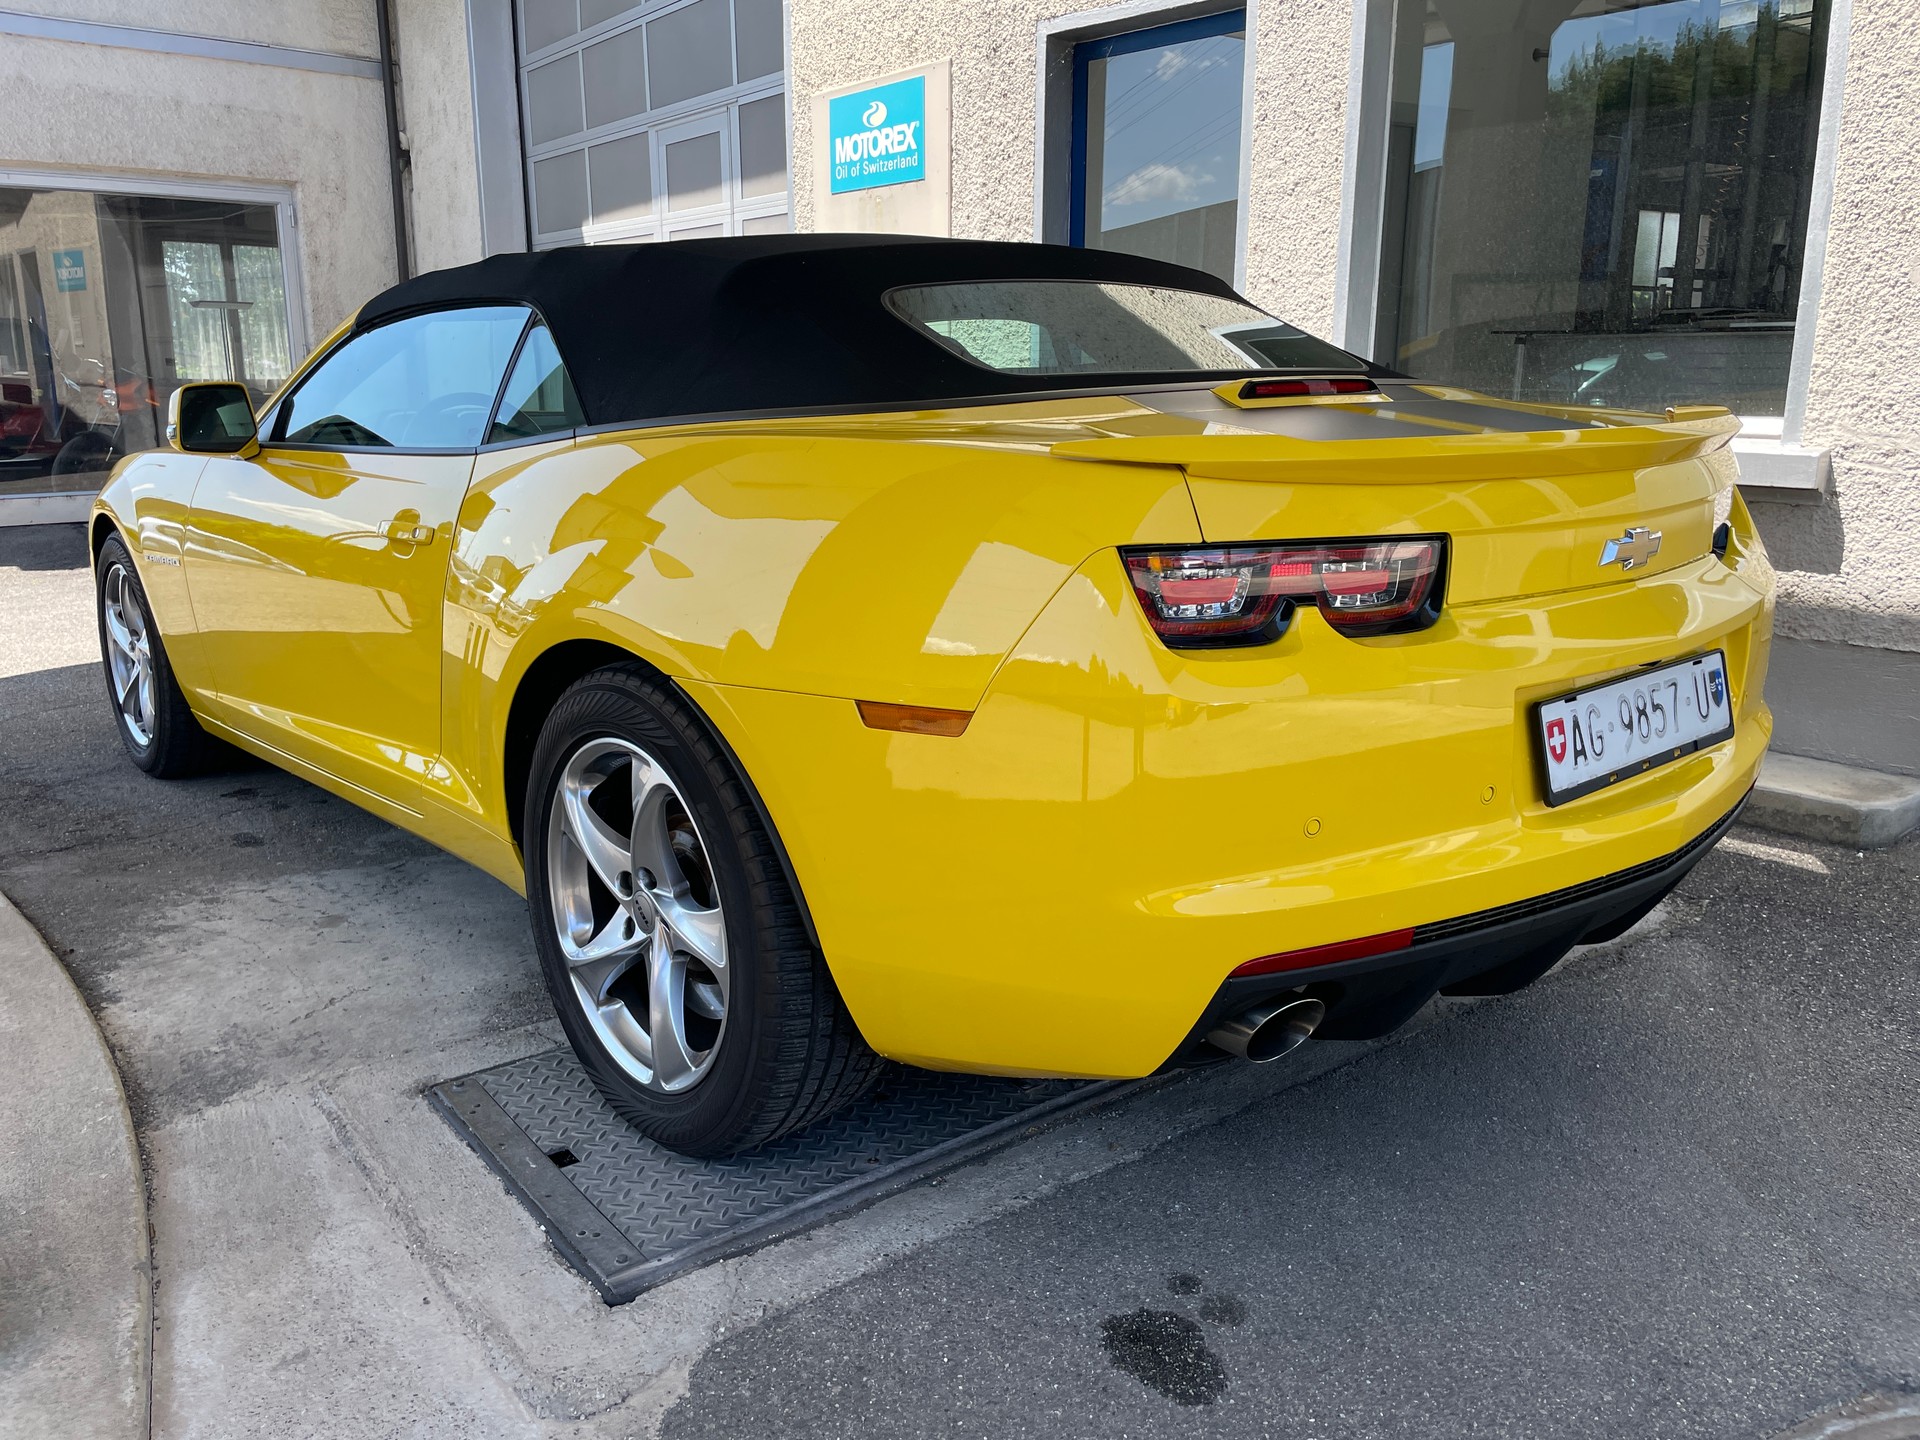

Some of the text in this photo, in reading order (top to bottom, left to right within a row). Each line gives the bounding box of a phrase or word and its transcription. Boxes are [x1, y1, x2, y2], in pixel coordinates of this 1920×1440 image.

[835, 121, 917, 164] MOTOREX
[835, 152, 919, 180] Oil of Switzerland
[145, 555, 181, 567] CAMARO
